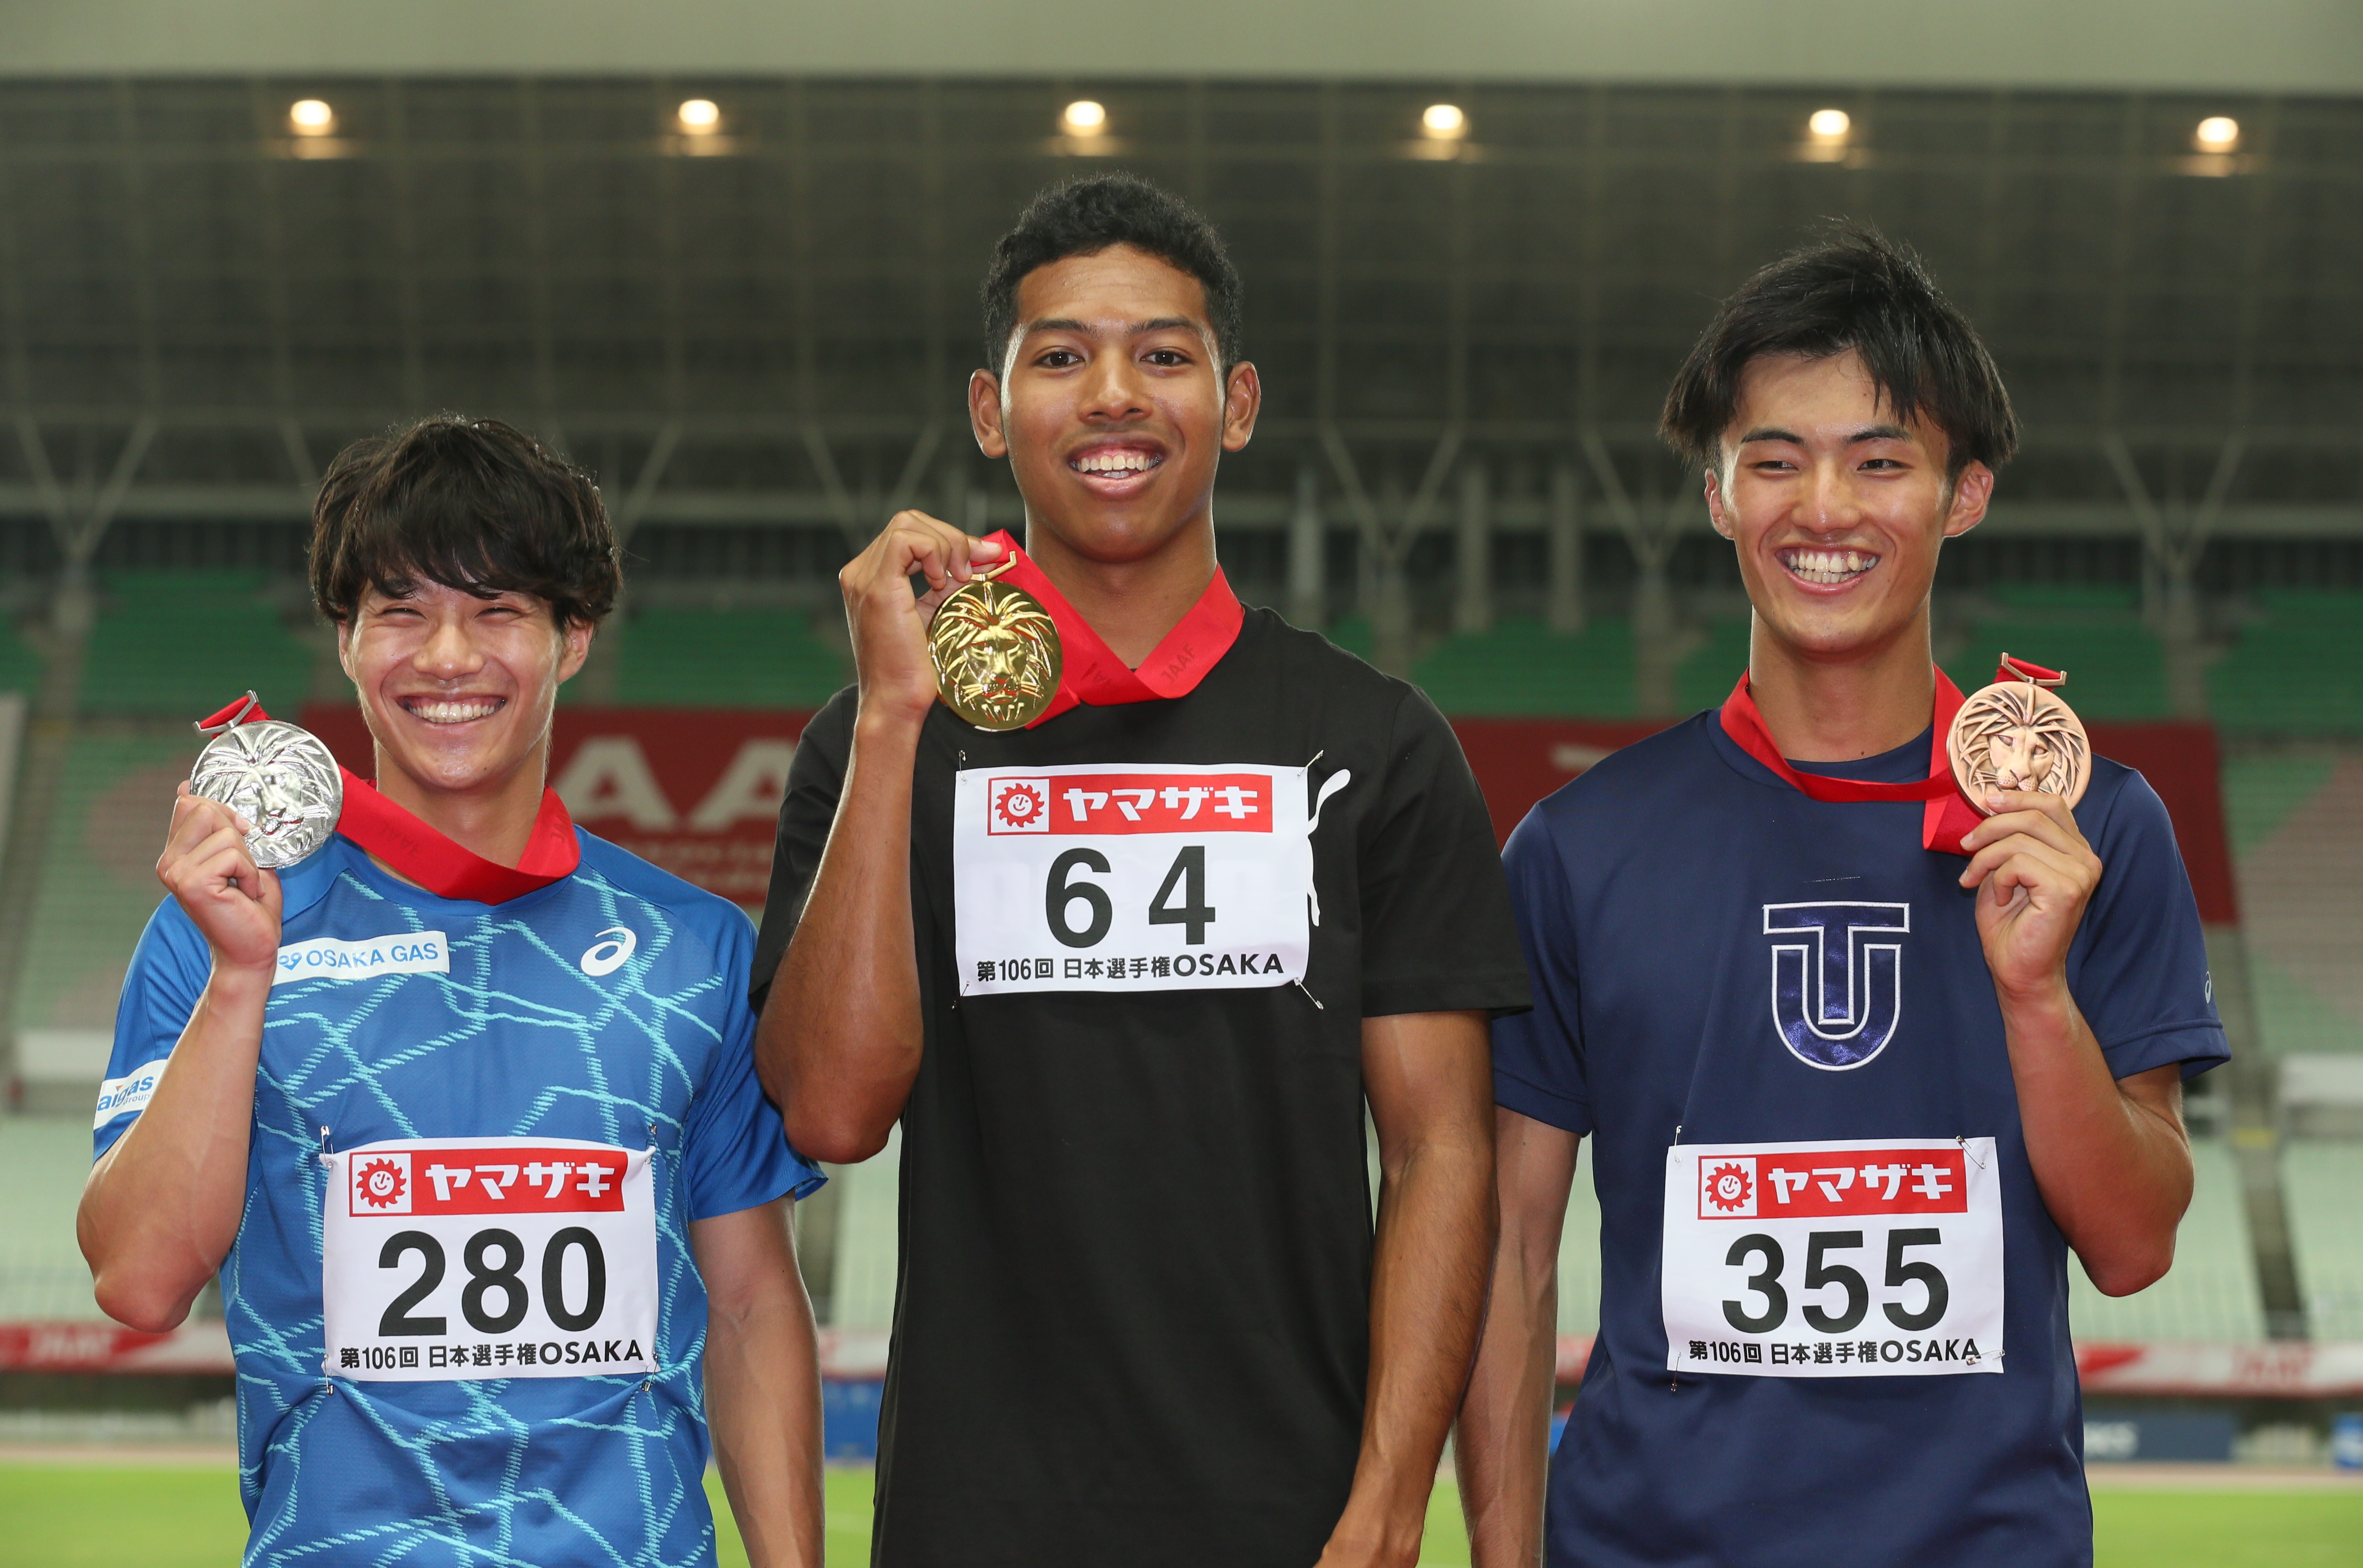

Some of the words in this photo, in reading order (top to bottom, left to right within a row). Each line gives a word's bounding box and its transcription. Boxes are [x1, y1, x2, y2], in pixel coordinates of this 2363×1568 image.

[1161, 643, 1195, 686] JAAF
[1062, 786, 1258, 821] ヤマザキ
[306, 949, 385, 968] OSAKA
[391, 942, 438, 962] GAS
[976, 958, 1053, 982] 第106回
[425, 1161, 614, 1201] ヤマザキ
[1768, 1164, 1952, 1204] ヤマザキ
[378, 1226, 606, 1336] 280
[1722, 1228, 1949, 1334] 355
[340, 1346, 419, 1369] 第106回
[1688, 1340, 1762, 1364] 第106回
